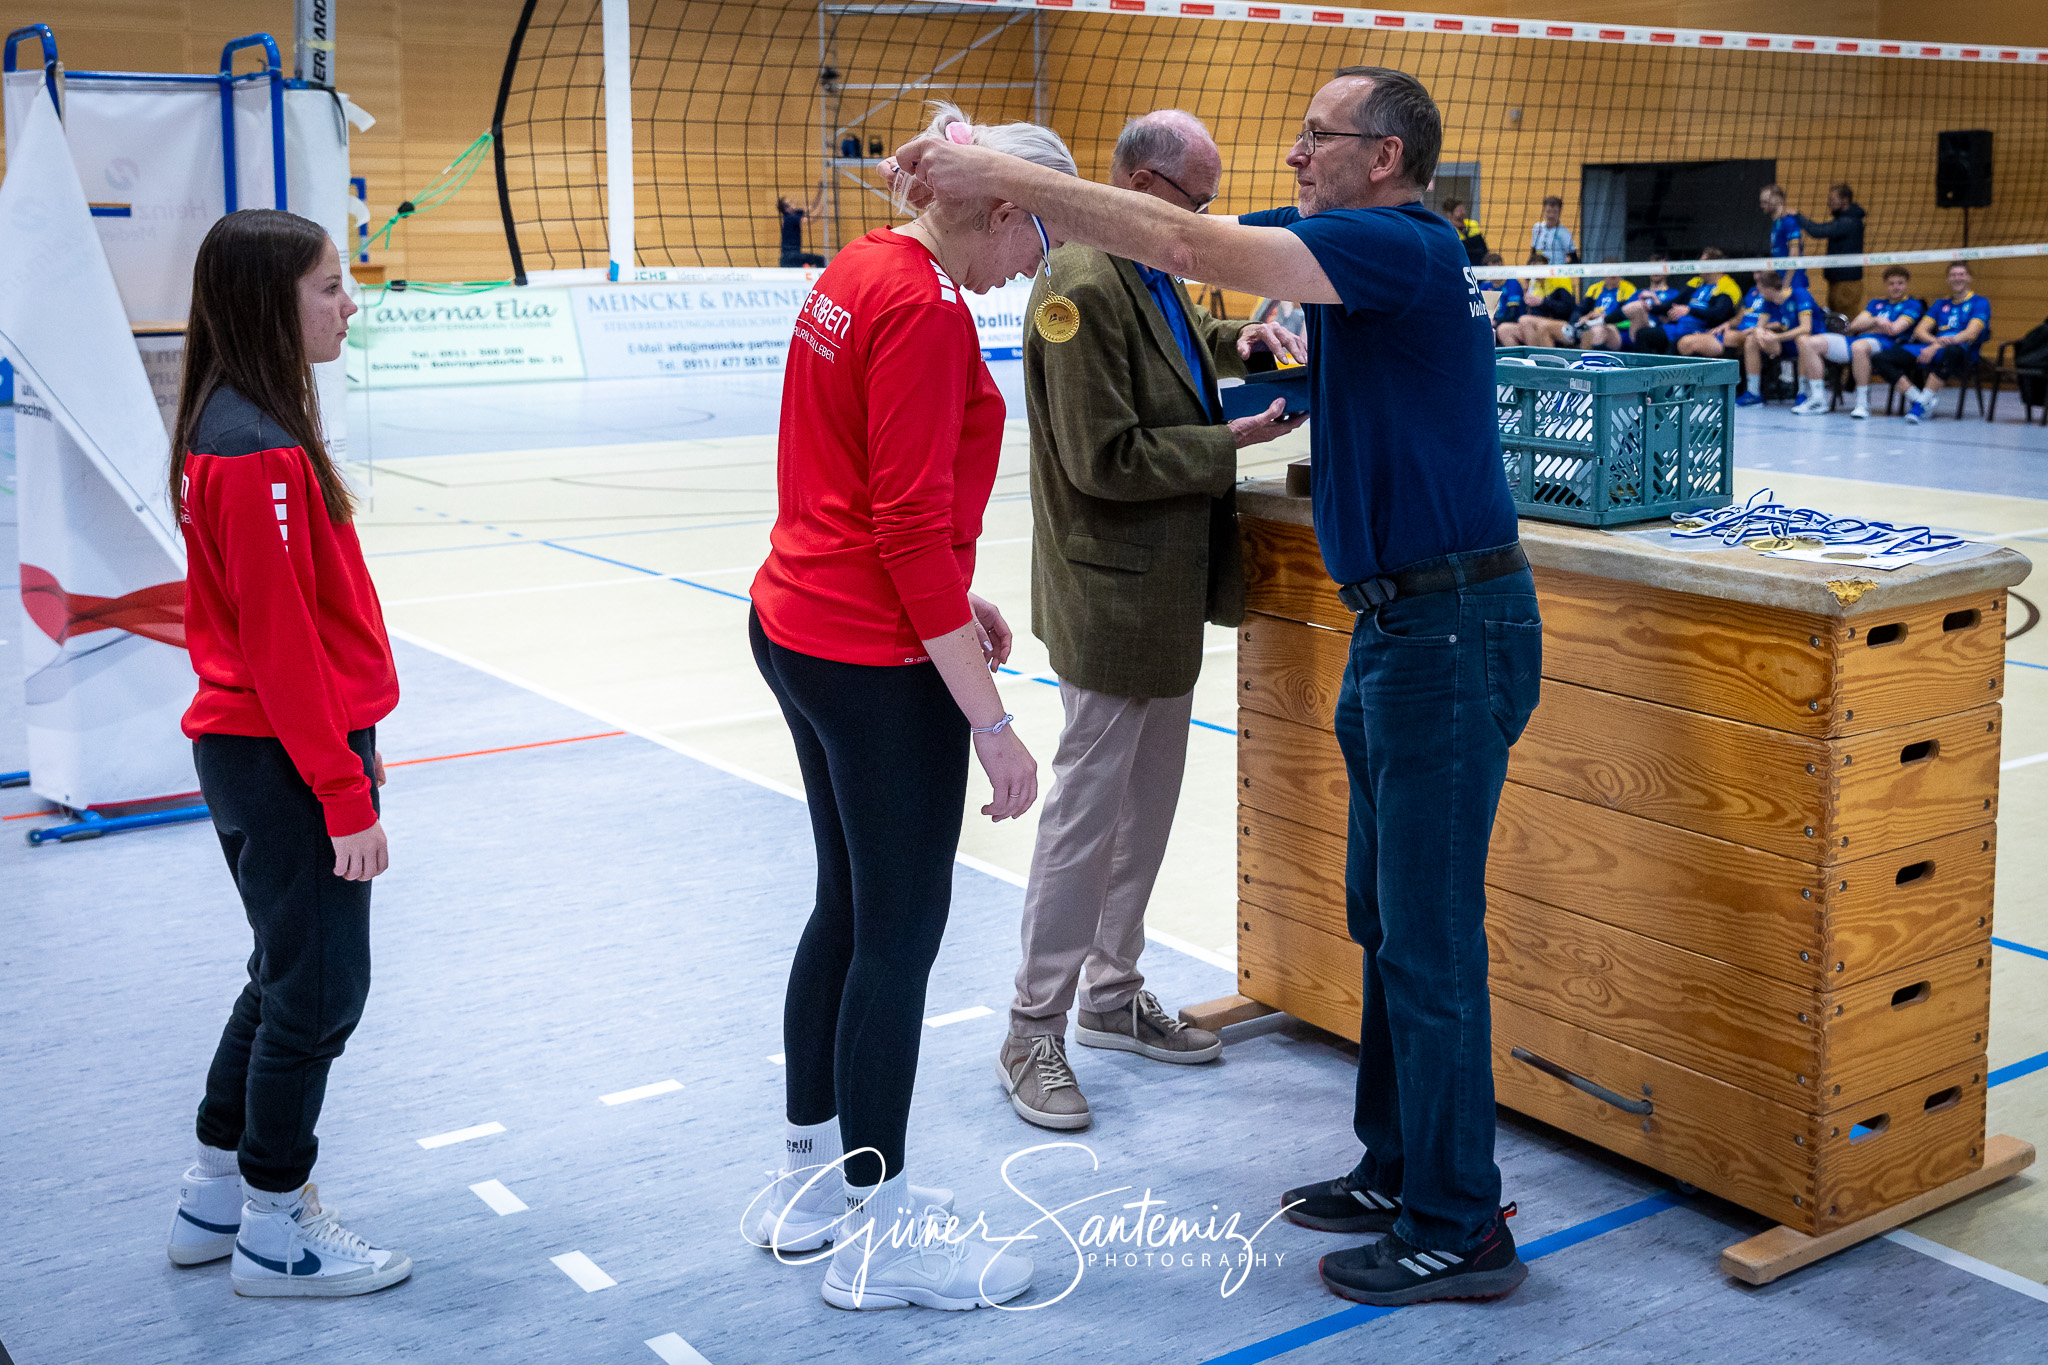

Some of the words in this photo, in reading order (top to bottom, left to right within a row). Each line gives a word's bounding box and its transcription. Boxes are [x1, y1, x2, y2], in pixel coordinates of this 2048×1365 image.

[375, 304, 490, 324] averna
[496, 298, 557, 321] Elia
[587, 291, 695, 313] MEINCKE
[699, 292, 717, 311] &
